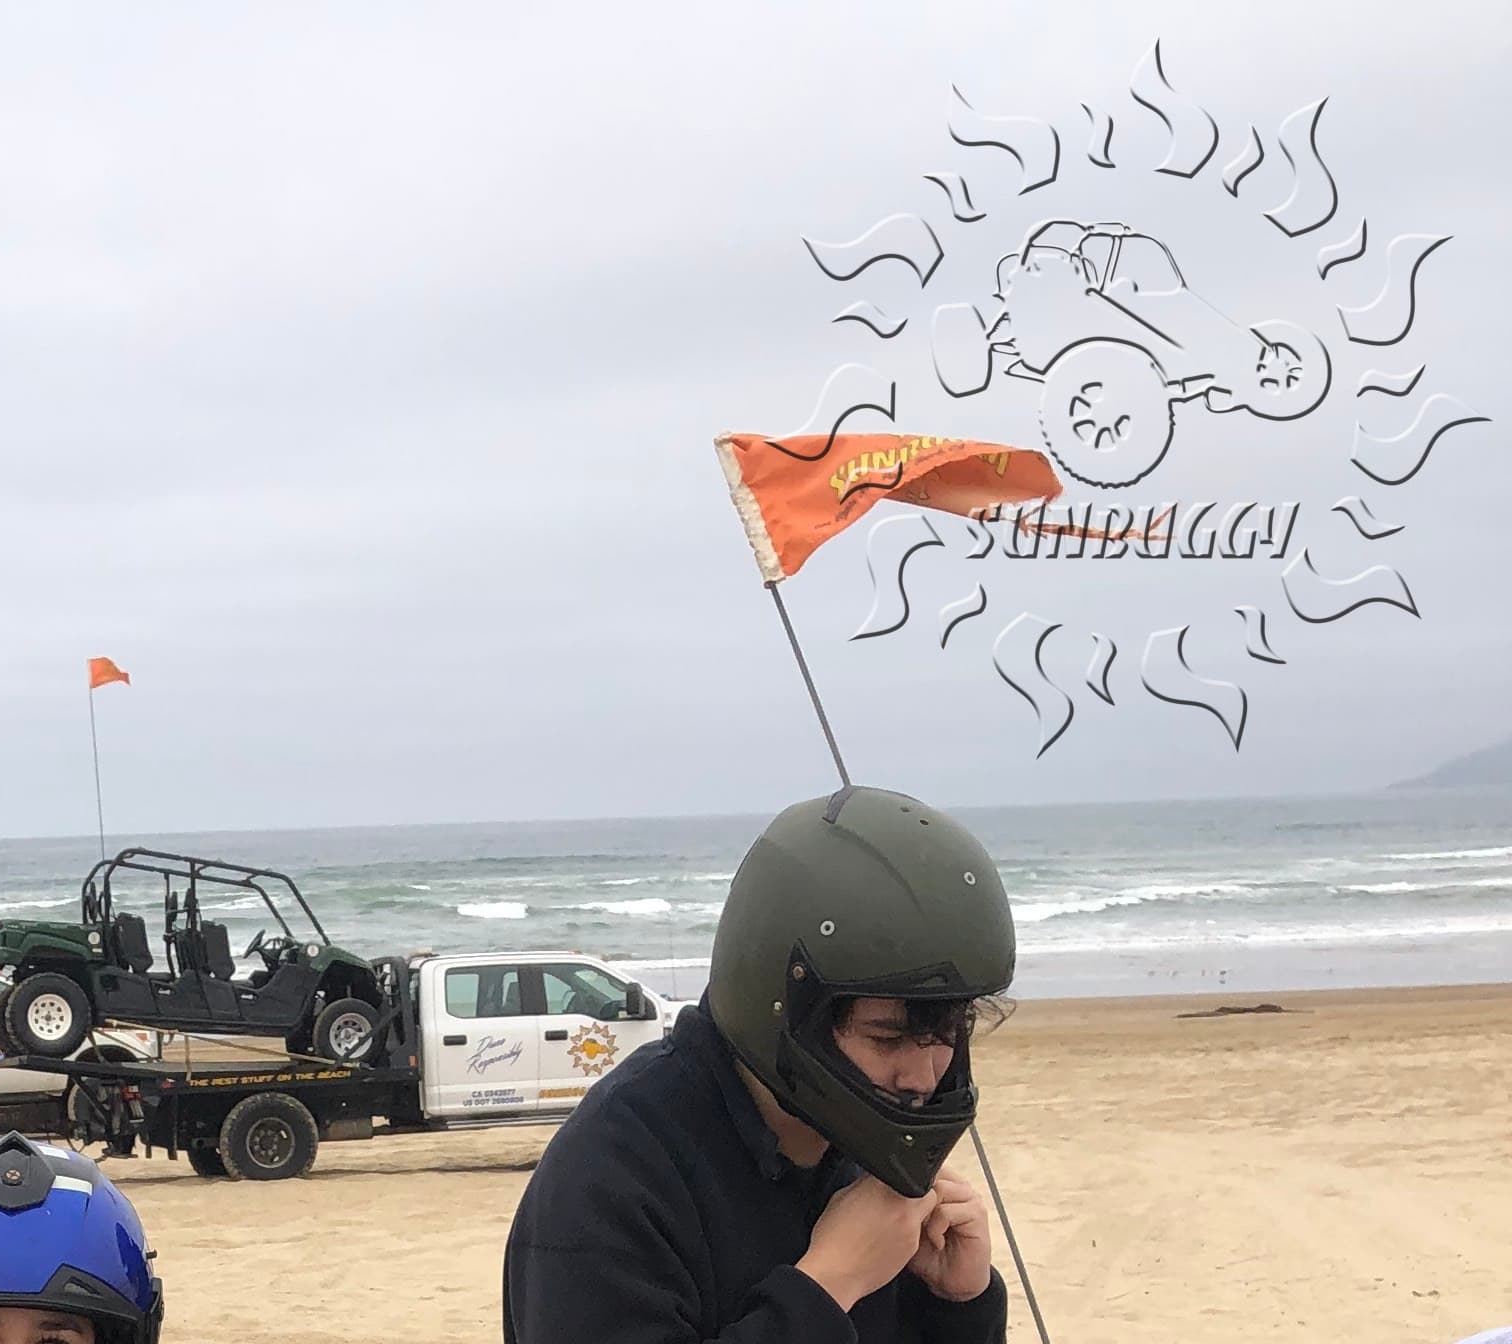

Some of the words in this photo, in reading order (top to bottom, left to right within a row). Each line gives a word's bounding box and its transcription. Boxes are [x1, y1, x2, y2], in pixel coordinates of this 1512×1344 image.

[190, 1079, 209, 1087] THE
[212, 1077, 238, 1087] BEST
[241, 1074, 274, 1084] STUFF
[276, 1074, 291, 1082] ON
[295, 1072, 315, 1081] THE
[317, 1070, 351, 1080] BEACH
